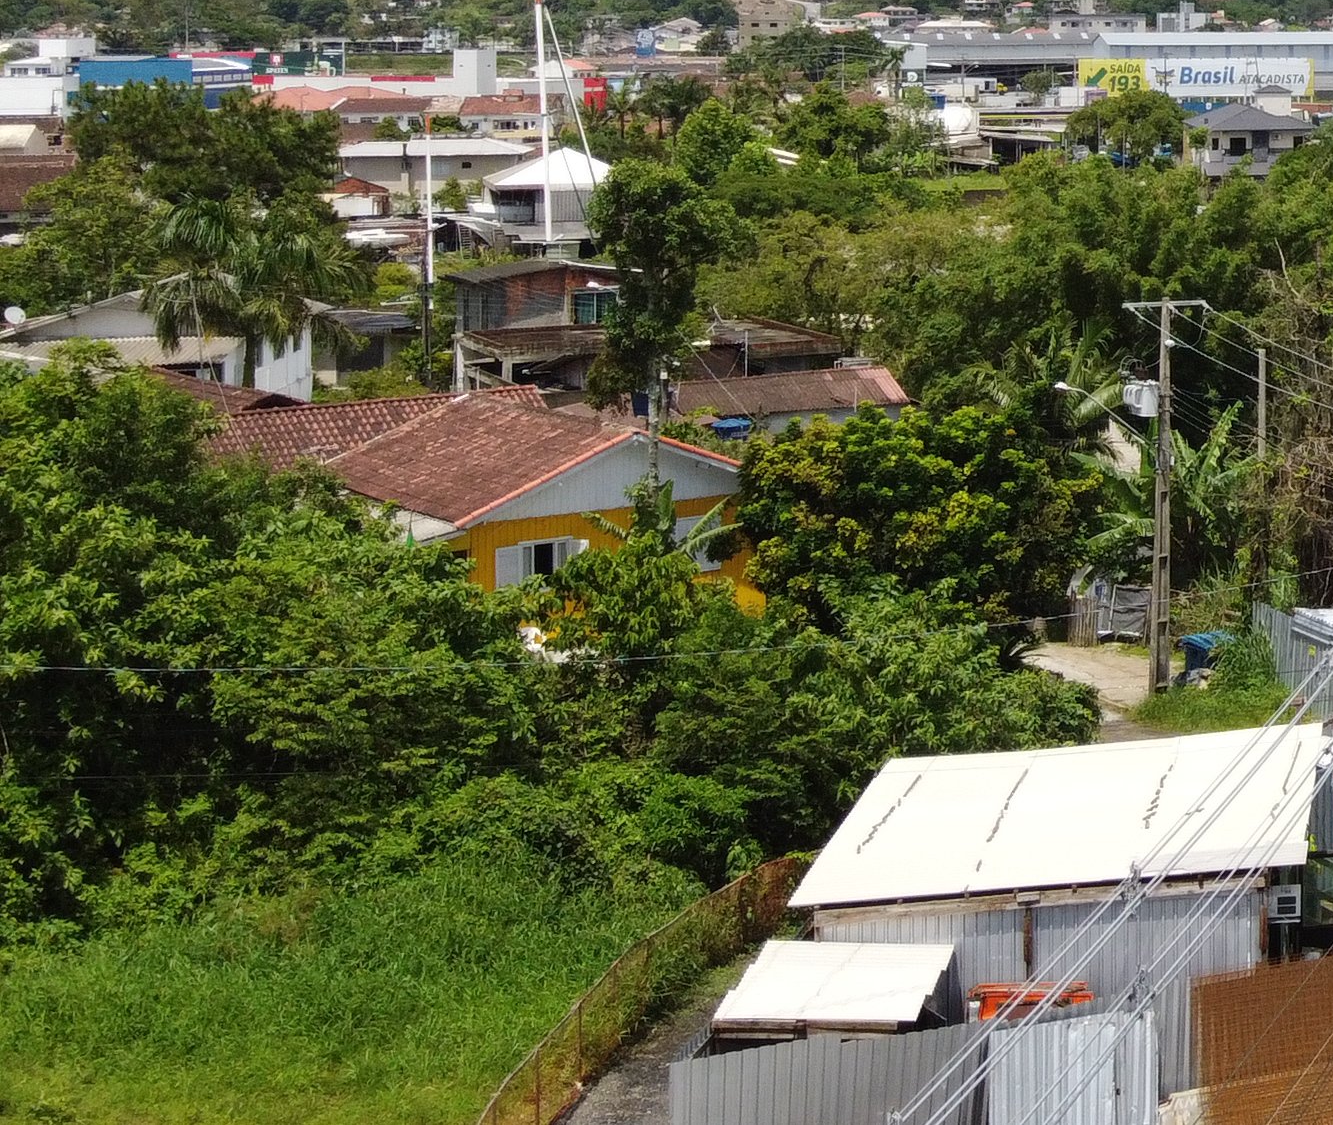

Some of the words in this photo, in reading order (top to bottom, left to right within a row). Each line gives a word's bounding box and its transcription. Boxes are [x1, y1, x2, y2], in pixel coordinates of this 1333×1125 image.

[1110, 62, 1141, 74] SAÍDA
[1179, 66, 1235, 85] Brasil
[1238, 74, 1305, 84] ATACADISTA
[1109, 75, 1141, 92] 193
